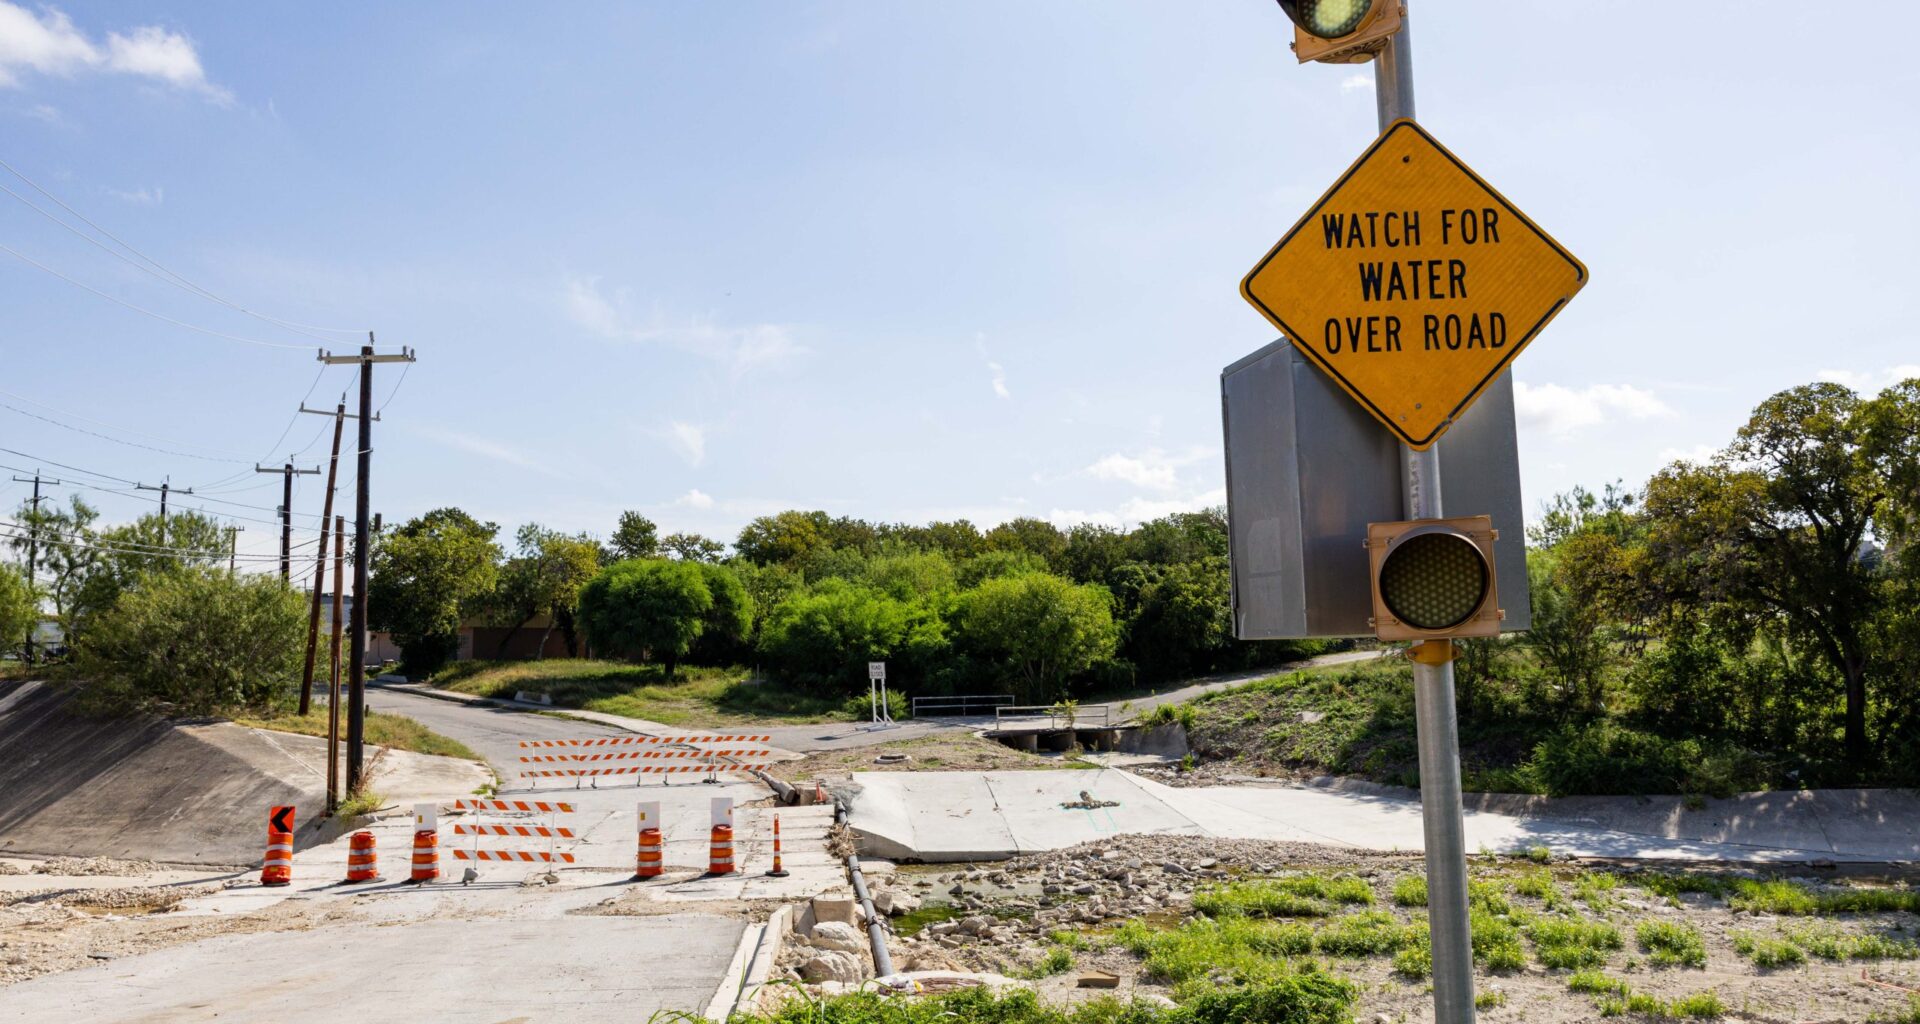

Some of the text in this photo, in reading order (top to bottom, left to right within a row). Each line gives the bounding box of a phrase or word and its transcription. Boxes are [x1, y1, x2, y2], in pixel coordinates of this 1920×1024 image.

[1322, 208, 1500, 249] WATCH FOR
[1359, 259, 1467, 302] WATER
[1324, 312, 1507, 354] OVER ROAD
